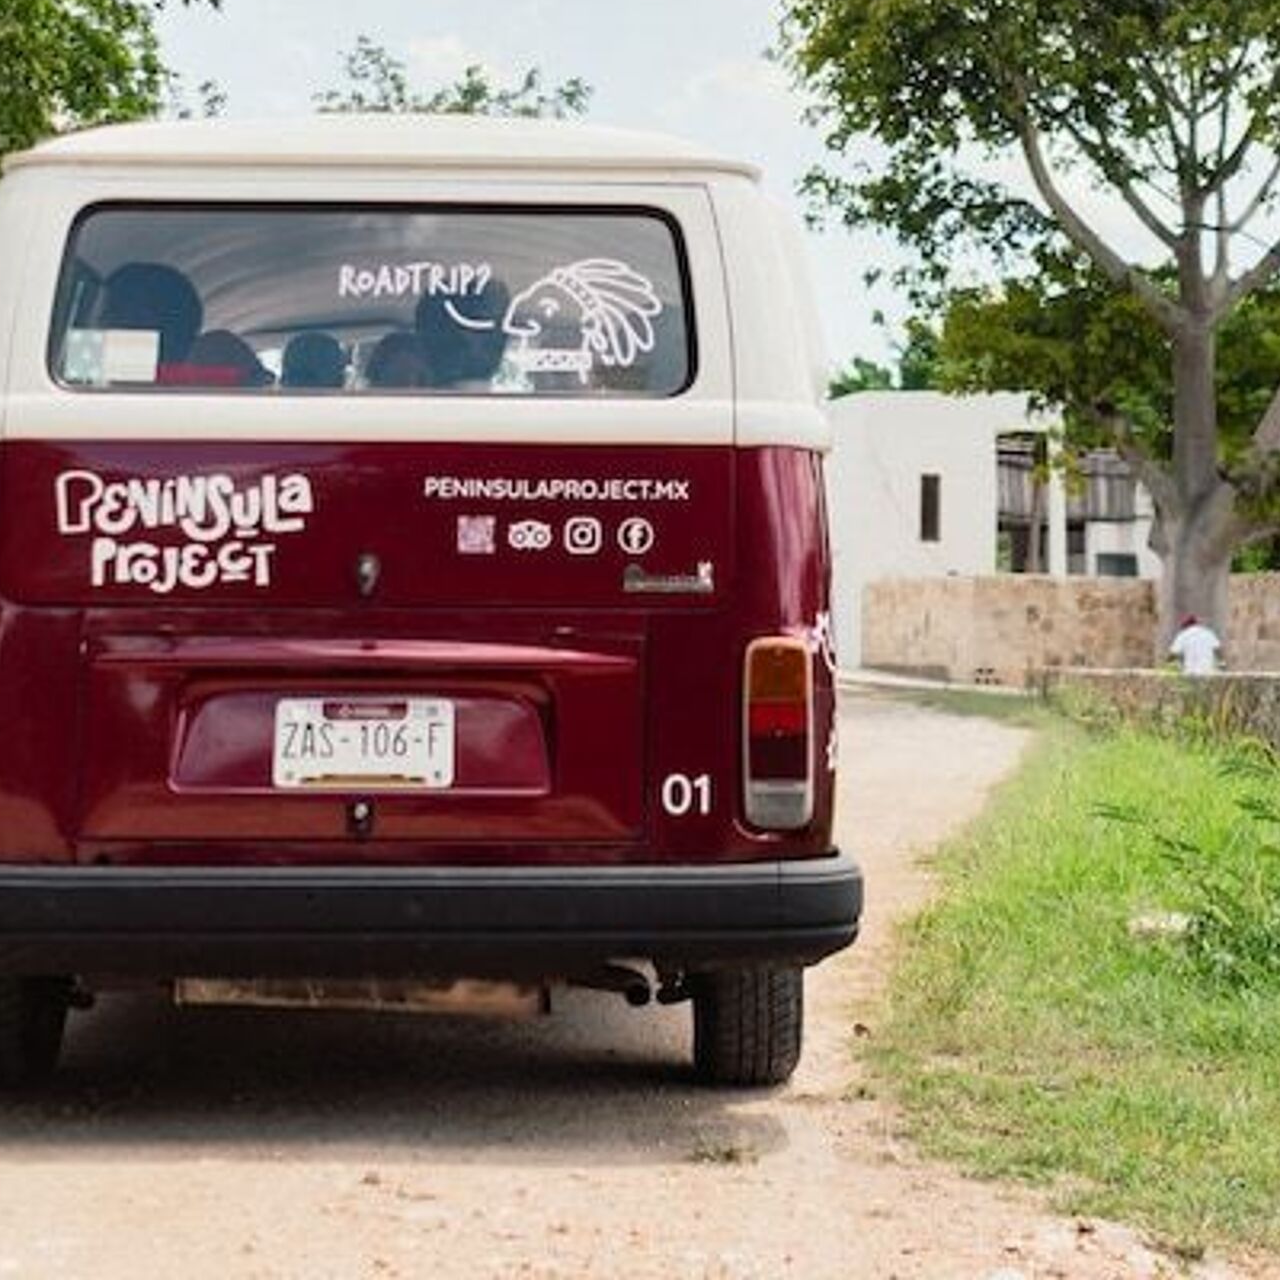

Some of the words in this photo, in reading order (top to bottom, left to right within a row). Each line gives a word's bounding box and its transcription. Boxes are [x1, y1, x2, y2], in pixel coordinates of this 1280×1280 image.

[424, 476, 690, 501] PENINSULAPROJECT.MX
[282, 722, 446, 759] ZAS-106-F
[662, 773, 711, 815] 01
